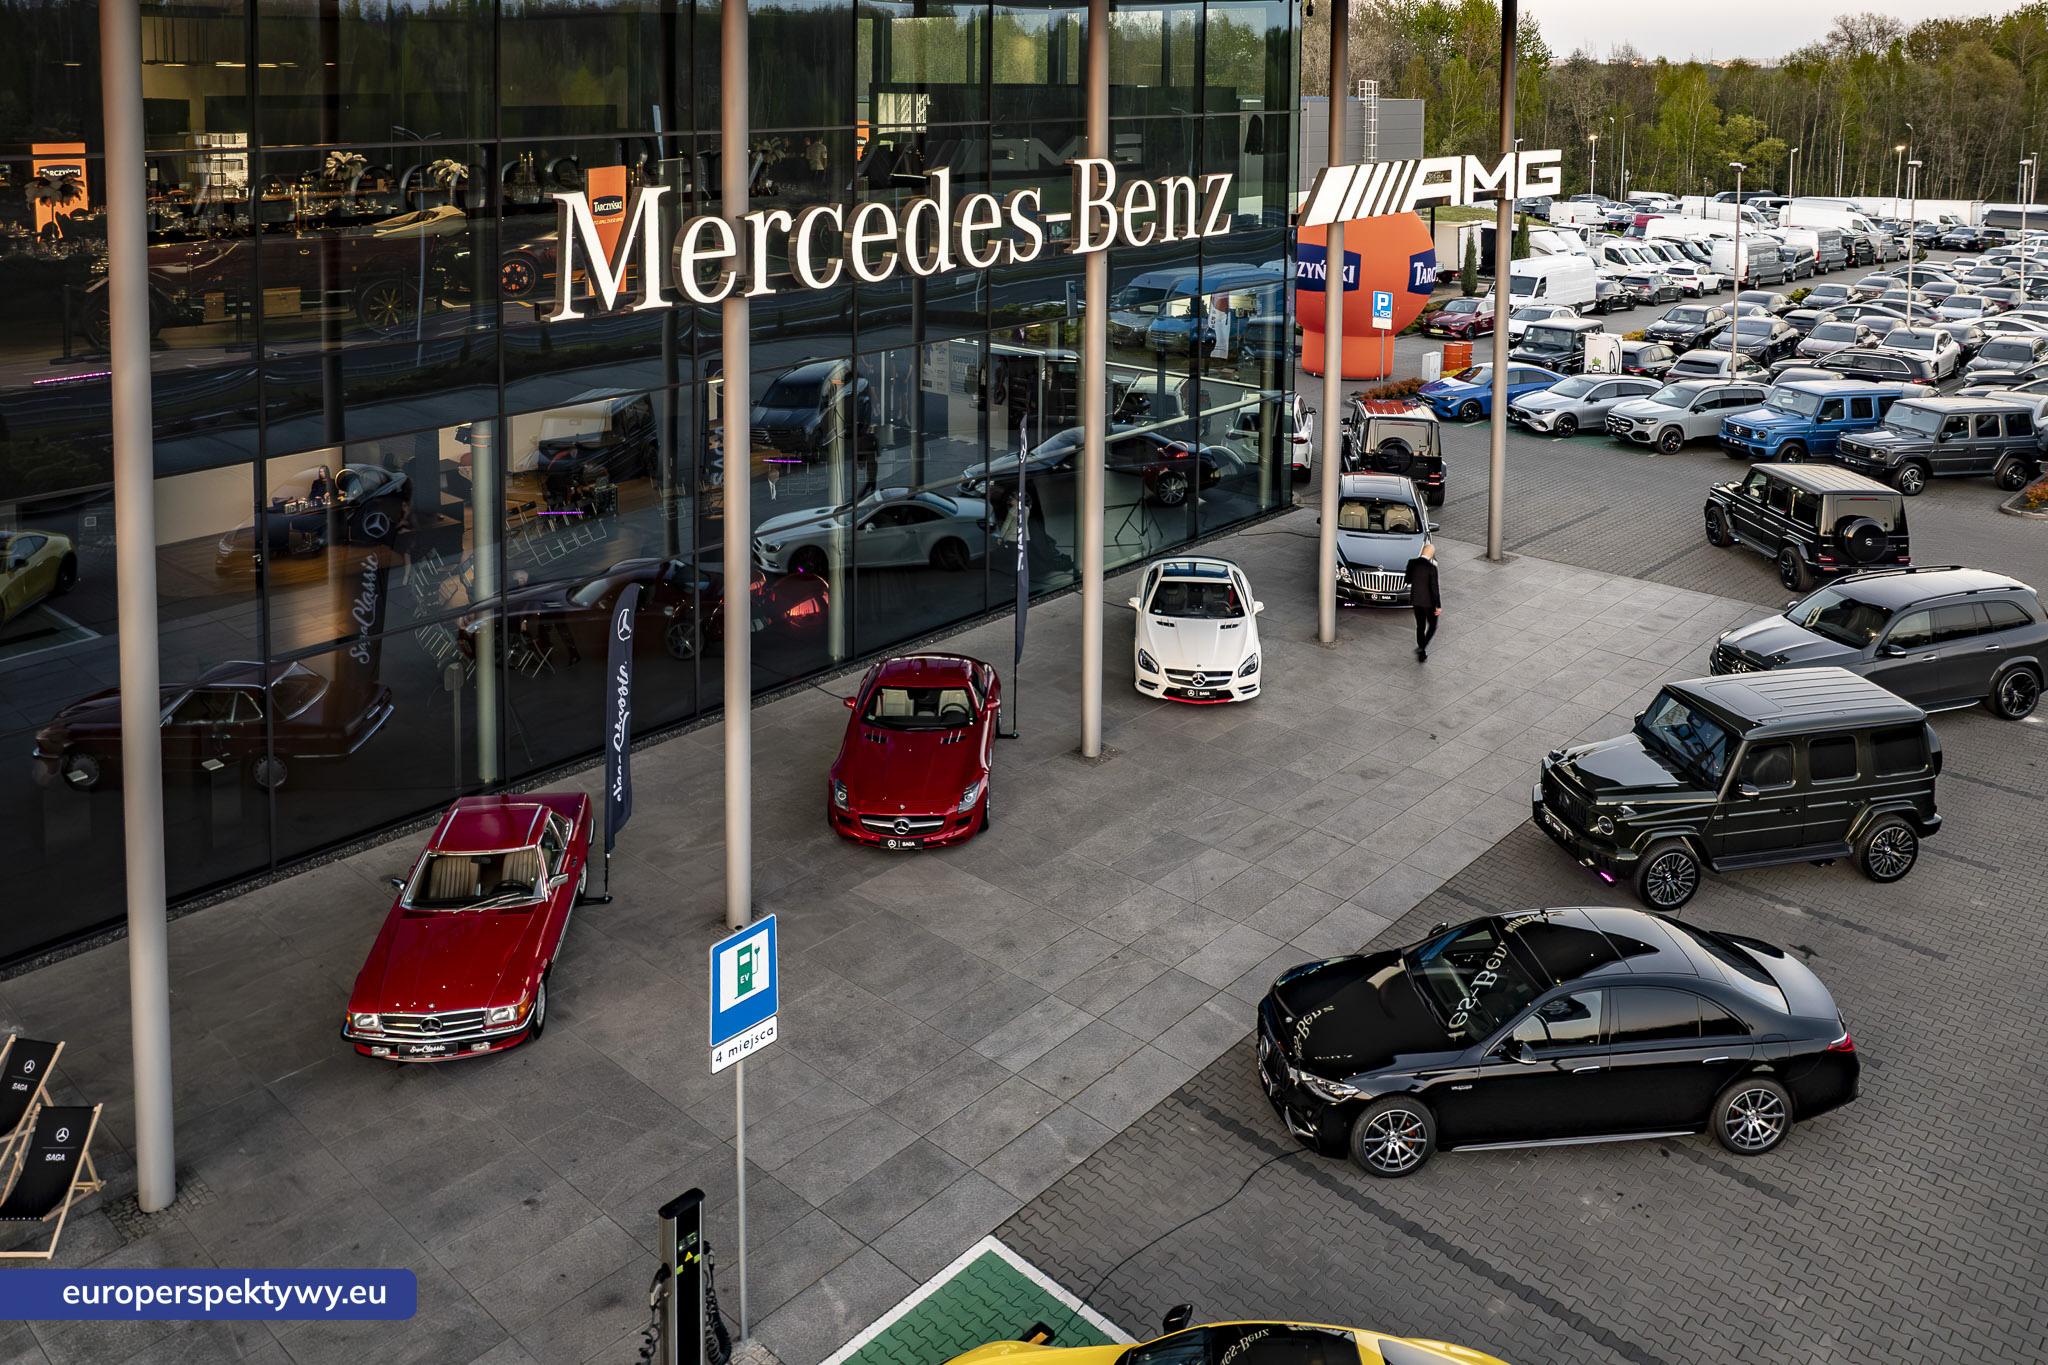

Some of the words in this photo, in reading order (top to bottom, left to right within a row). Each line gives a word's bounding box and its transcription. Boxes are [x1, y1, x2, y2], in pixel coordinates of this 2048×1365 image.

[1400, 149, 1562, 214] AMG
[551, 158, 1234, 322] Mercedes-Benz
[1297, 259, 1355, 284] ZYŃKI
[1377, 294, 1389, 310] P
[740, 973, 749, 984] EV
[715, 1052, 722, 1063] 4
[728, 1027, 773, 1057] miejsca
[12, 1082, 28, 1091] SAGA
[45, 1153, 66, 1162] SAGA
